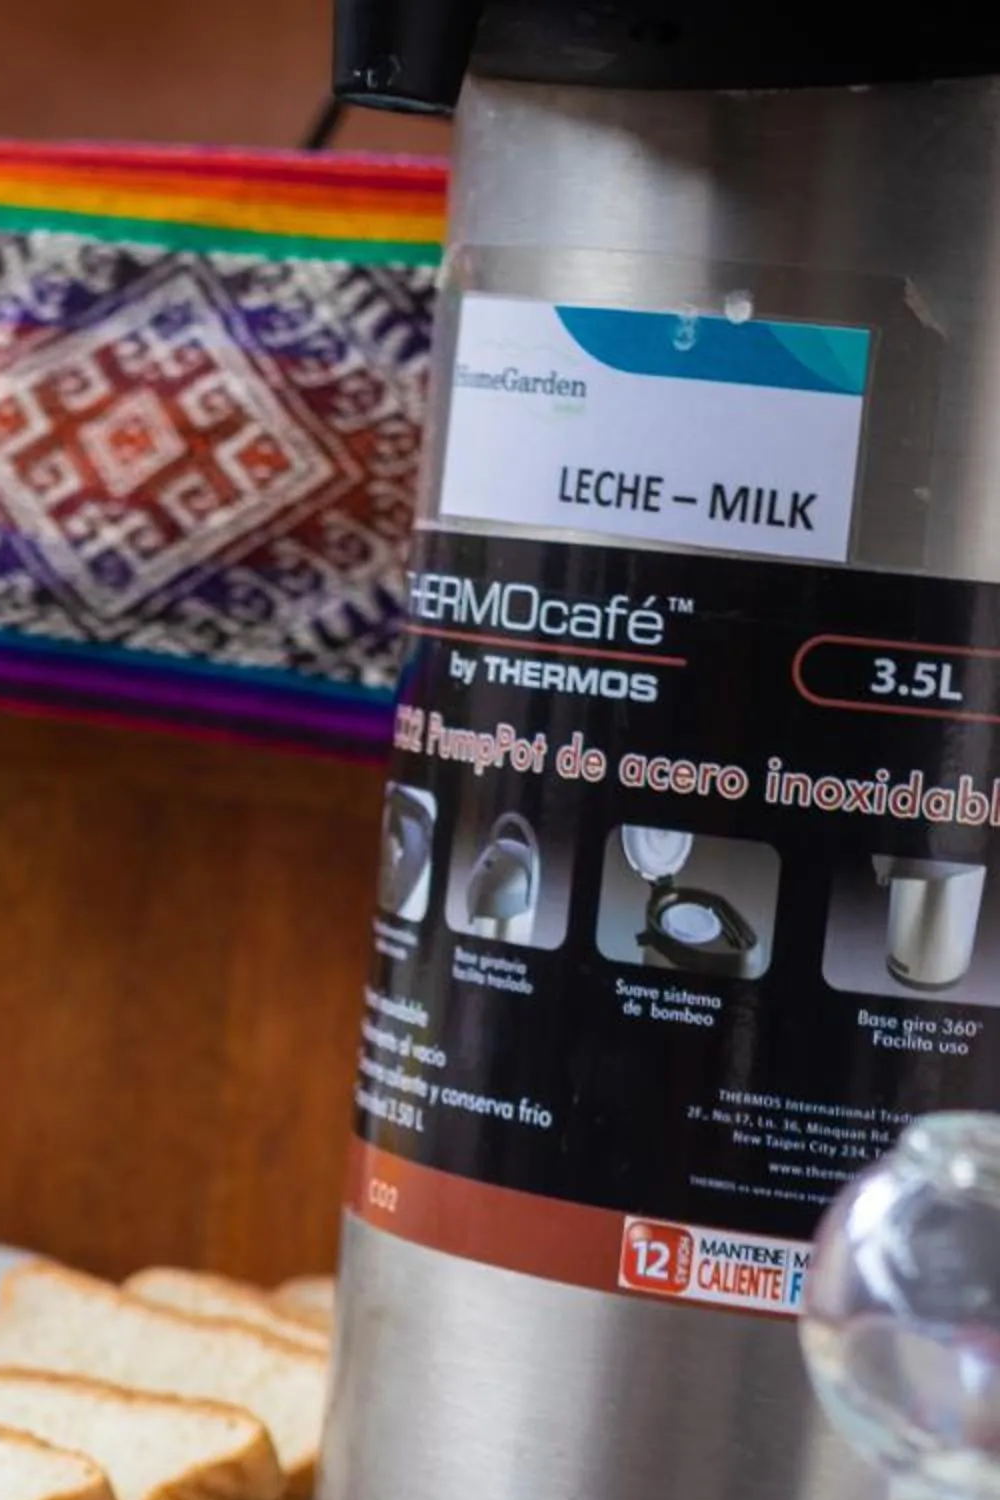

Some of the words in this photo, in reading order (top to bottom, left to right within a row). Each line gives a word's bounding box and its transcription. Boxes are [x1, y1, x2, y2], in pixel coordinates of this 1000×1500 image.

[558, 465, 664, 513] LECHE
[708, 482, 818, 531] MILK
[450, 650, 477, 685] by
[483, 654, 659, 703] THERMOS
[870, 657, 964, 701] 3.5L
[426, 711, 548, 777] PumpPot
[555, 731, 607, 782] de
[618, 752, 749, 800] acero
[765, 756, 1000, 827] inoxidabl
[615, 977, 660, 1000] Suave
[663, 985, 722, 1010] sistema
[622, 998, 643, 1017] de
[650, 1001, 715, 1027] bombeo
[857, 1008, 898, 1030] Base
[902, 1014, 938, 1036] gira
[872, 1029, 934, 1052] Facilita
[939, 1041, 970, 1056] uso
[441, 1087, 515, 1121] conserva
[718, 1088, 782, 1110] THERMOS
[785, 1097, 876, 1121] International
[732, 1129, 762, 1147] New
[765, 1133, 806, 1152] Taipei
[808, 1138, 838, 1159] City
[805, 1120, 867, 1143] Minquan
[631, 1239, 670, 1281] 12
[700, 1236, 783, 1266] MANTIENE
[697, 1259, 783, 1301] CALIENTE
